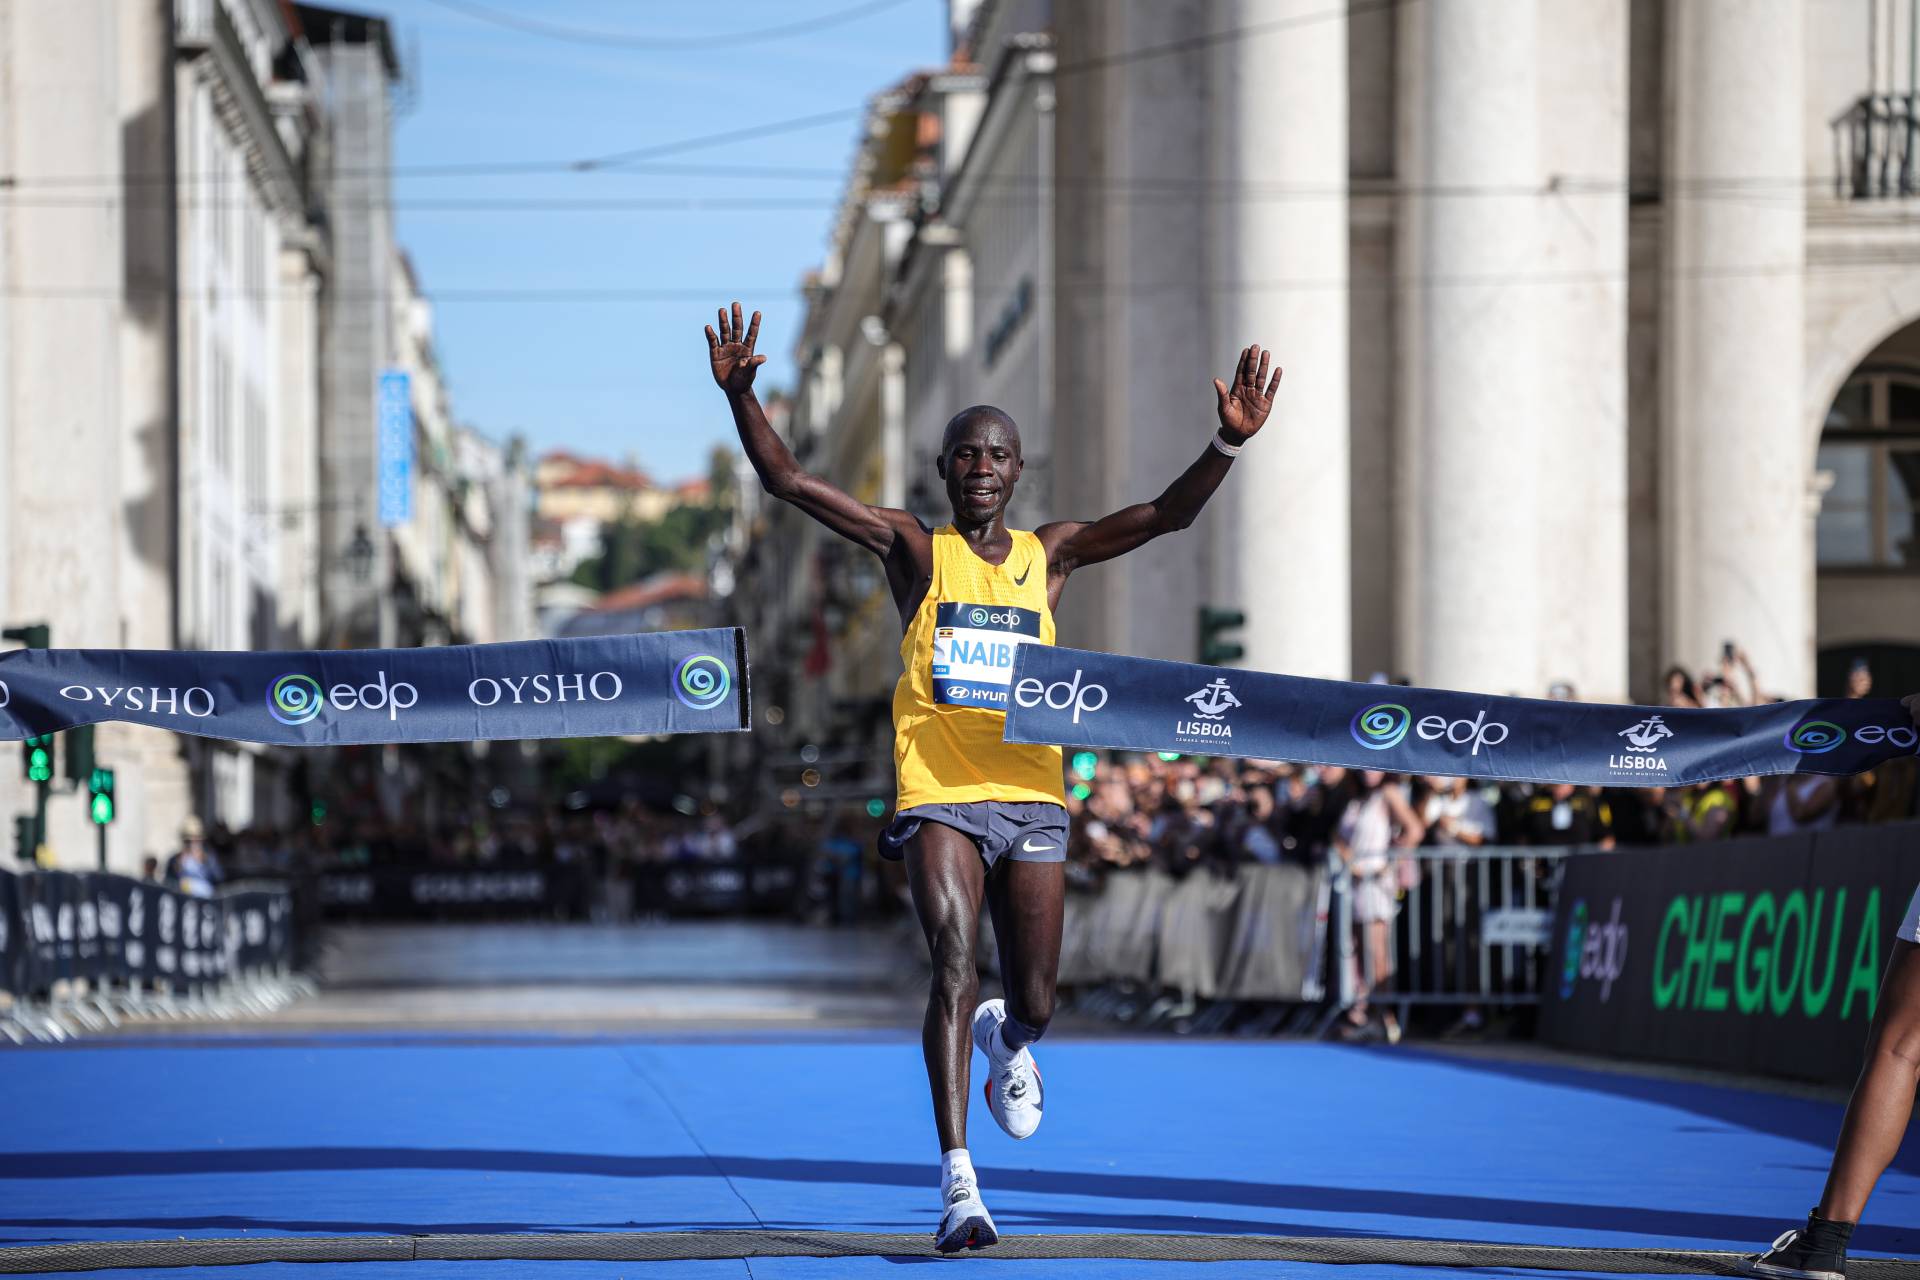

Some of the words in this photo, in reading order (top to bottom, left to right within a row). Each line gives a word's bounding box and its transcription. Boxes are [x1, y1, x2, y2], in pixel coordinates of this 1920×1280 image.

[990, 610, 1020, 628] edp
[949, 639, 1017, 668] NAIB
[59, 685, 215, 717] OYSHO
[329, 671, 418, 721] edp
[468, 671, 623, 706] OYSHO
[1014, 669, 1108, 724] edp
[1176, 721, 1232, 737] LISBOA
[1416, 710, 1509, 755] edp
[1609, 754, 1668, 770] LISBOA
[1652, 888, 1846, 1017] CHEGOU
[1840, 886, 1881, 1021] A
